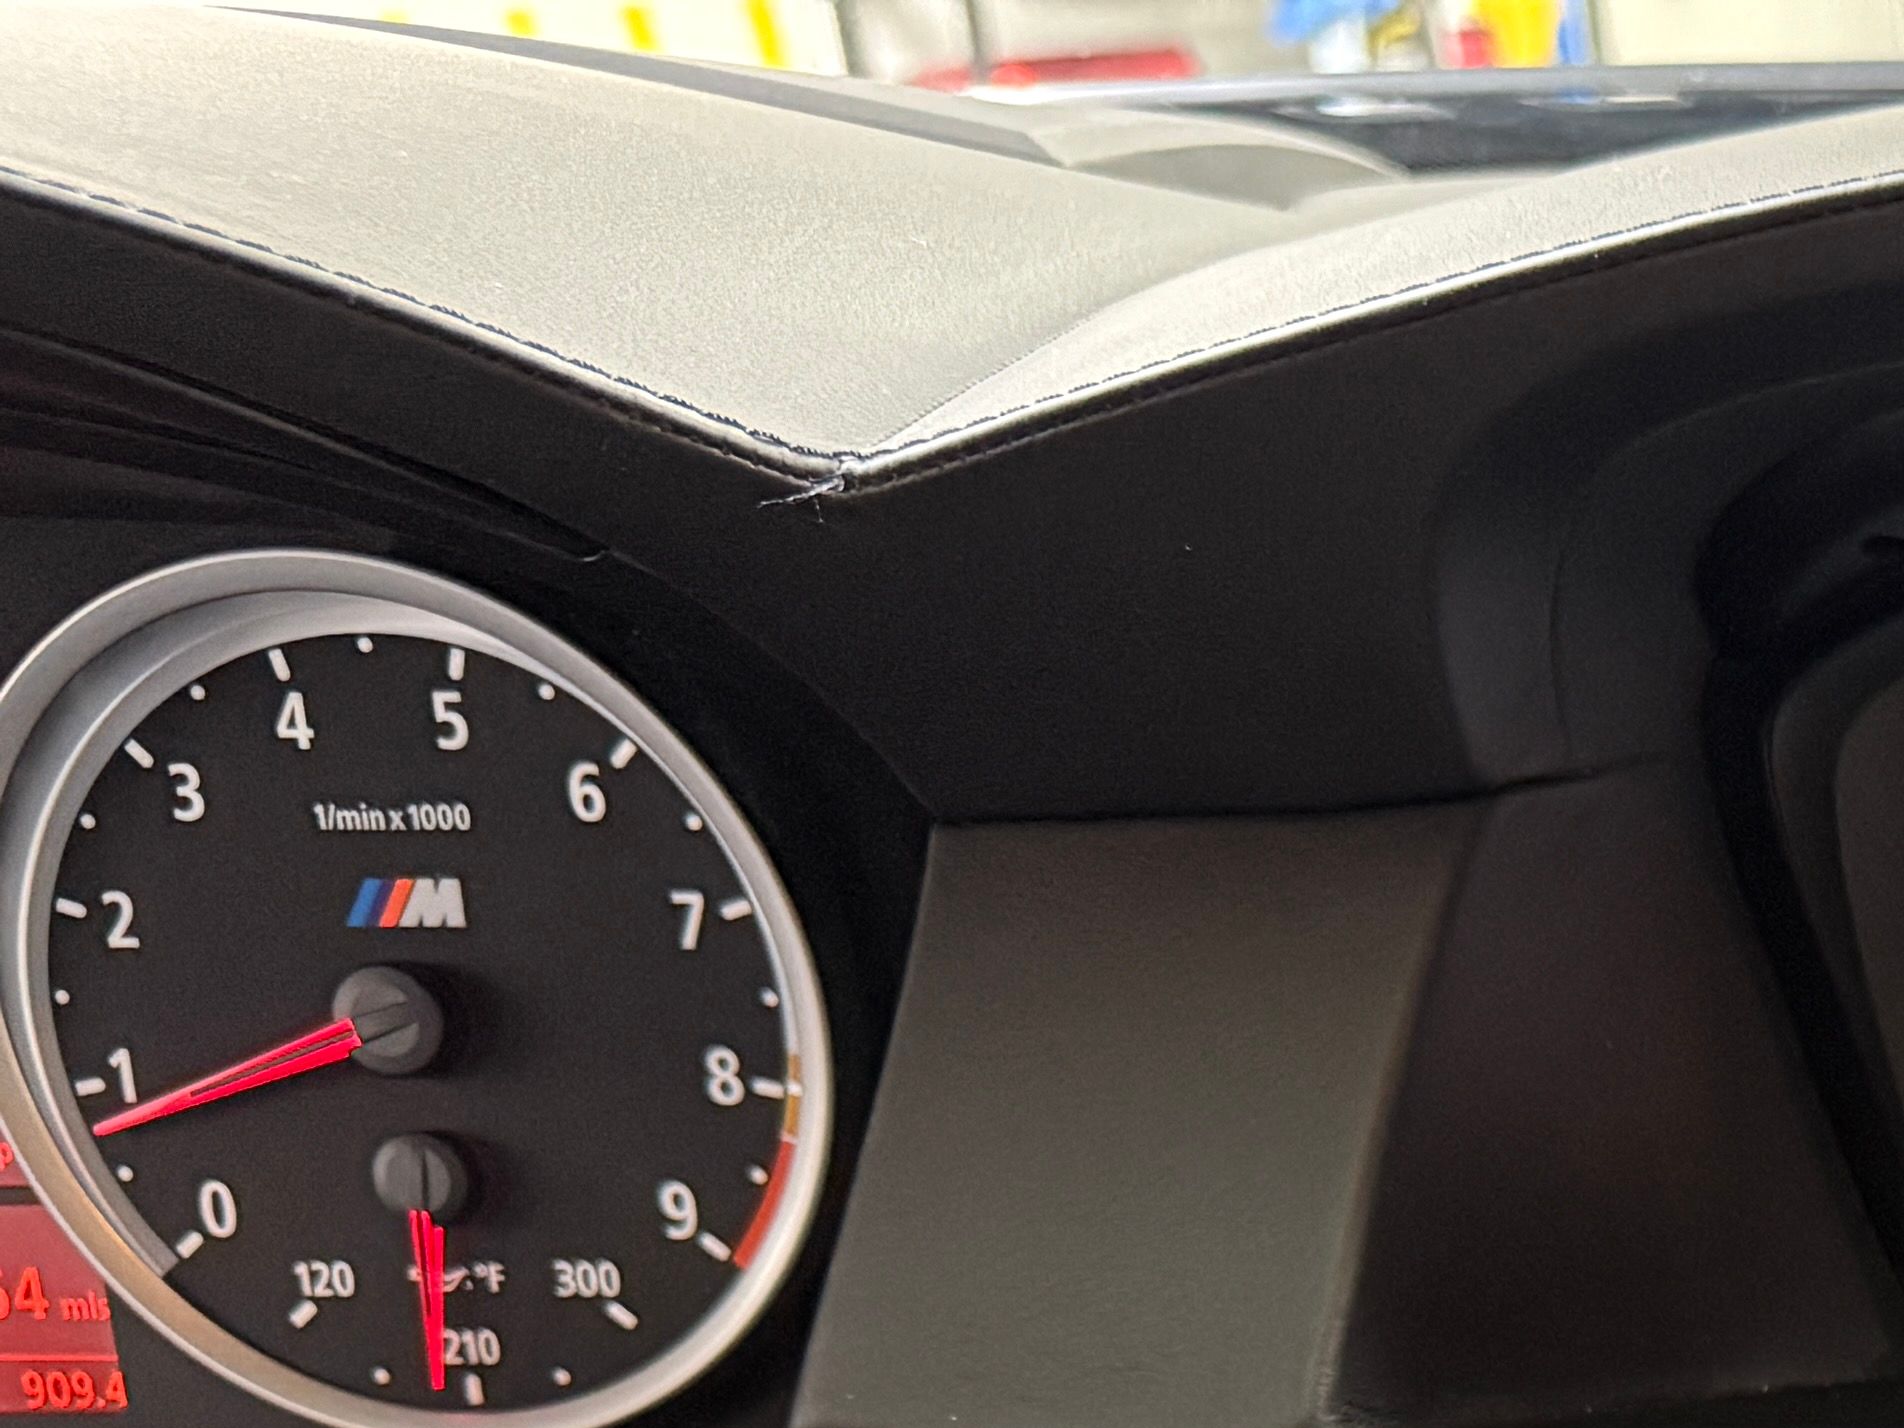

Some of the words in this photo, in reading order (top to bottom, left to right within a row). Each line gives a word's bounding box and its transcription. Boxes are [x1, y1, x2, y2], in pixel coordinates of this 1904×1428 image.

[277, 693, 314, 749] 4
[432, 691, 469, 750] 5
[170, 763, 205, 822] 3
[313, 802, 386, 831] 1/min
[388, 808, 407, 831] x
[407, 803, 471, 831] 1000
[568, 763, 606, 822] 6
[104, 892, 140, 949] 2
[670, 893, 704, 949] 7
[110, 1048, 137, 1102] 1
[707, 1048, 744, 1106] 8
[200, 1181, 237, 1238] 0
[661, 1181, 698, 1238] 9
[294, 1262, 355, 1298] 120
[553, 1261, 621, 1298] 300
[444, 1327, 501, 1366] 210
[21, 1369, 128, 1410] 909.4
